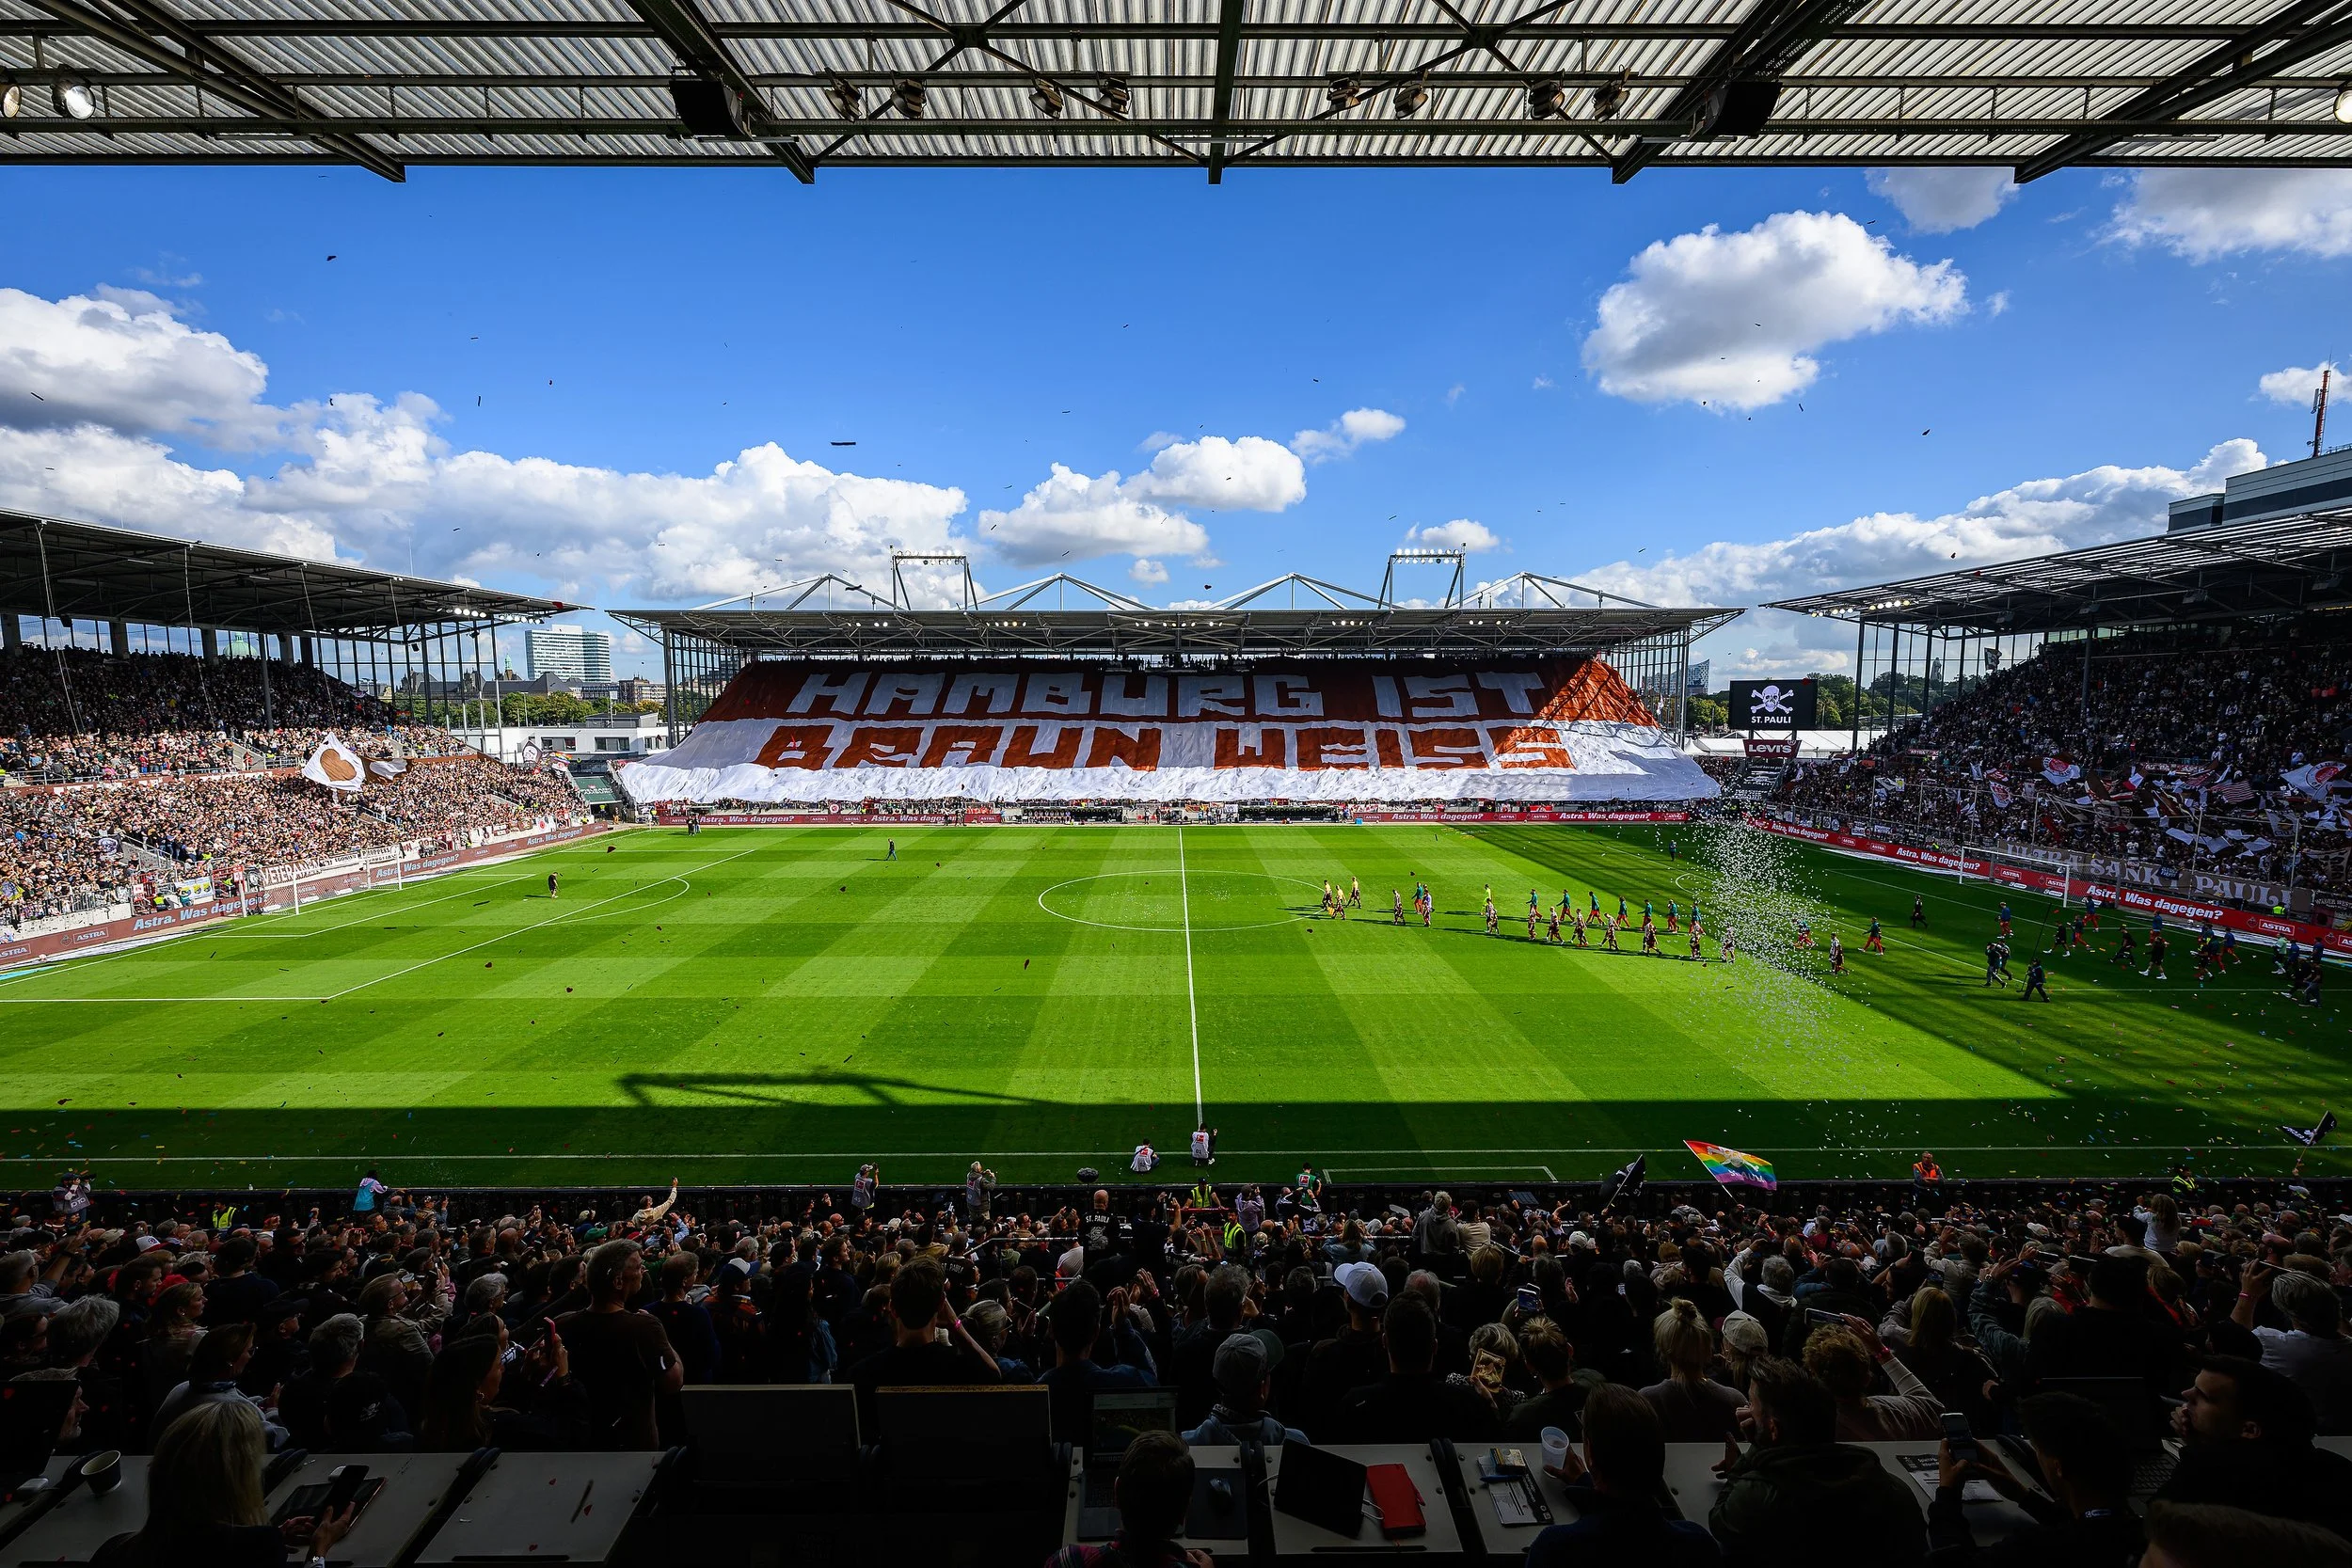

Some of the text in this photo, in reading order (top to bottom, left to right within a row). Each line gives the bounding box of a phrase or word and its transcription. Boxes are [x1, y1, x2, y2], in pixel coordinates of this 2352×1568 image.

[787, 671, 1545, 719] HAMBURG IST
[753, 724, 1578, 772] BRAUN WEISS
[750, 816, 795, 825] dagegen?
[1440, 813, 1484, 822] dagegen?
[1608, 812, 1651, 821] dagegen?
[527, 829, 583, 846] Astra. Was dagegen?
[1788, 825, 1801, 836] Was
[1801, 827, 1829, 841] dagegen?
[404, 862, 421, 873] Was
[422, 853, 460, 870] dagegen?
[1897, 847, 1980, 871] Astra. Was dagegen?
[2001, 869, 2020, 879] ASTRA
[2195, 875, 2293, 911] PAULI
[2087, 884, 2224, 921] Astra. Was dagegen?
[134, 915, 177, 931] Astra.
[180, 908, 209, 922] Was
[75, 929, 107, 942] ASTRA
[2261, 922, 2292, 934] ASTRA
[1094, 1214, 1110, 1224] PAULI
